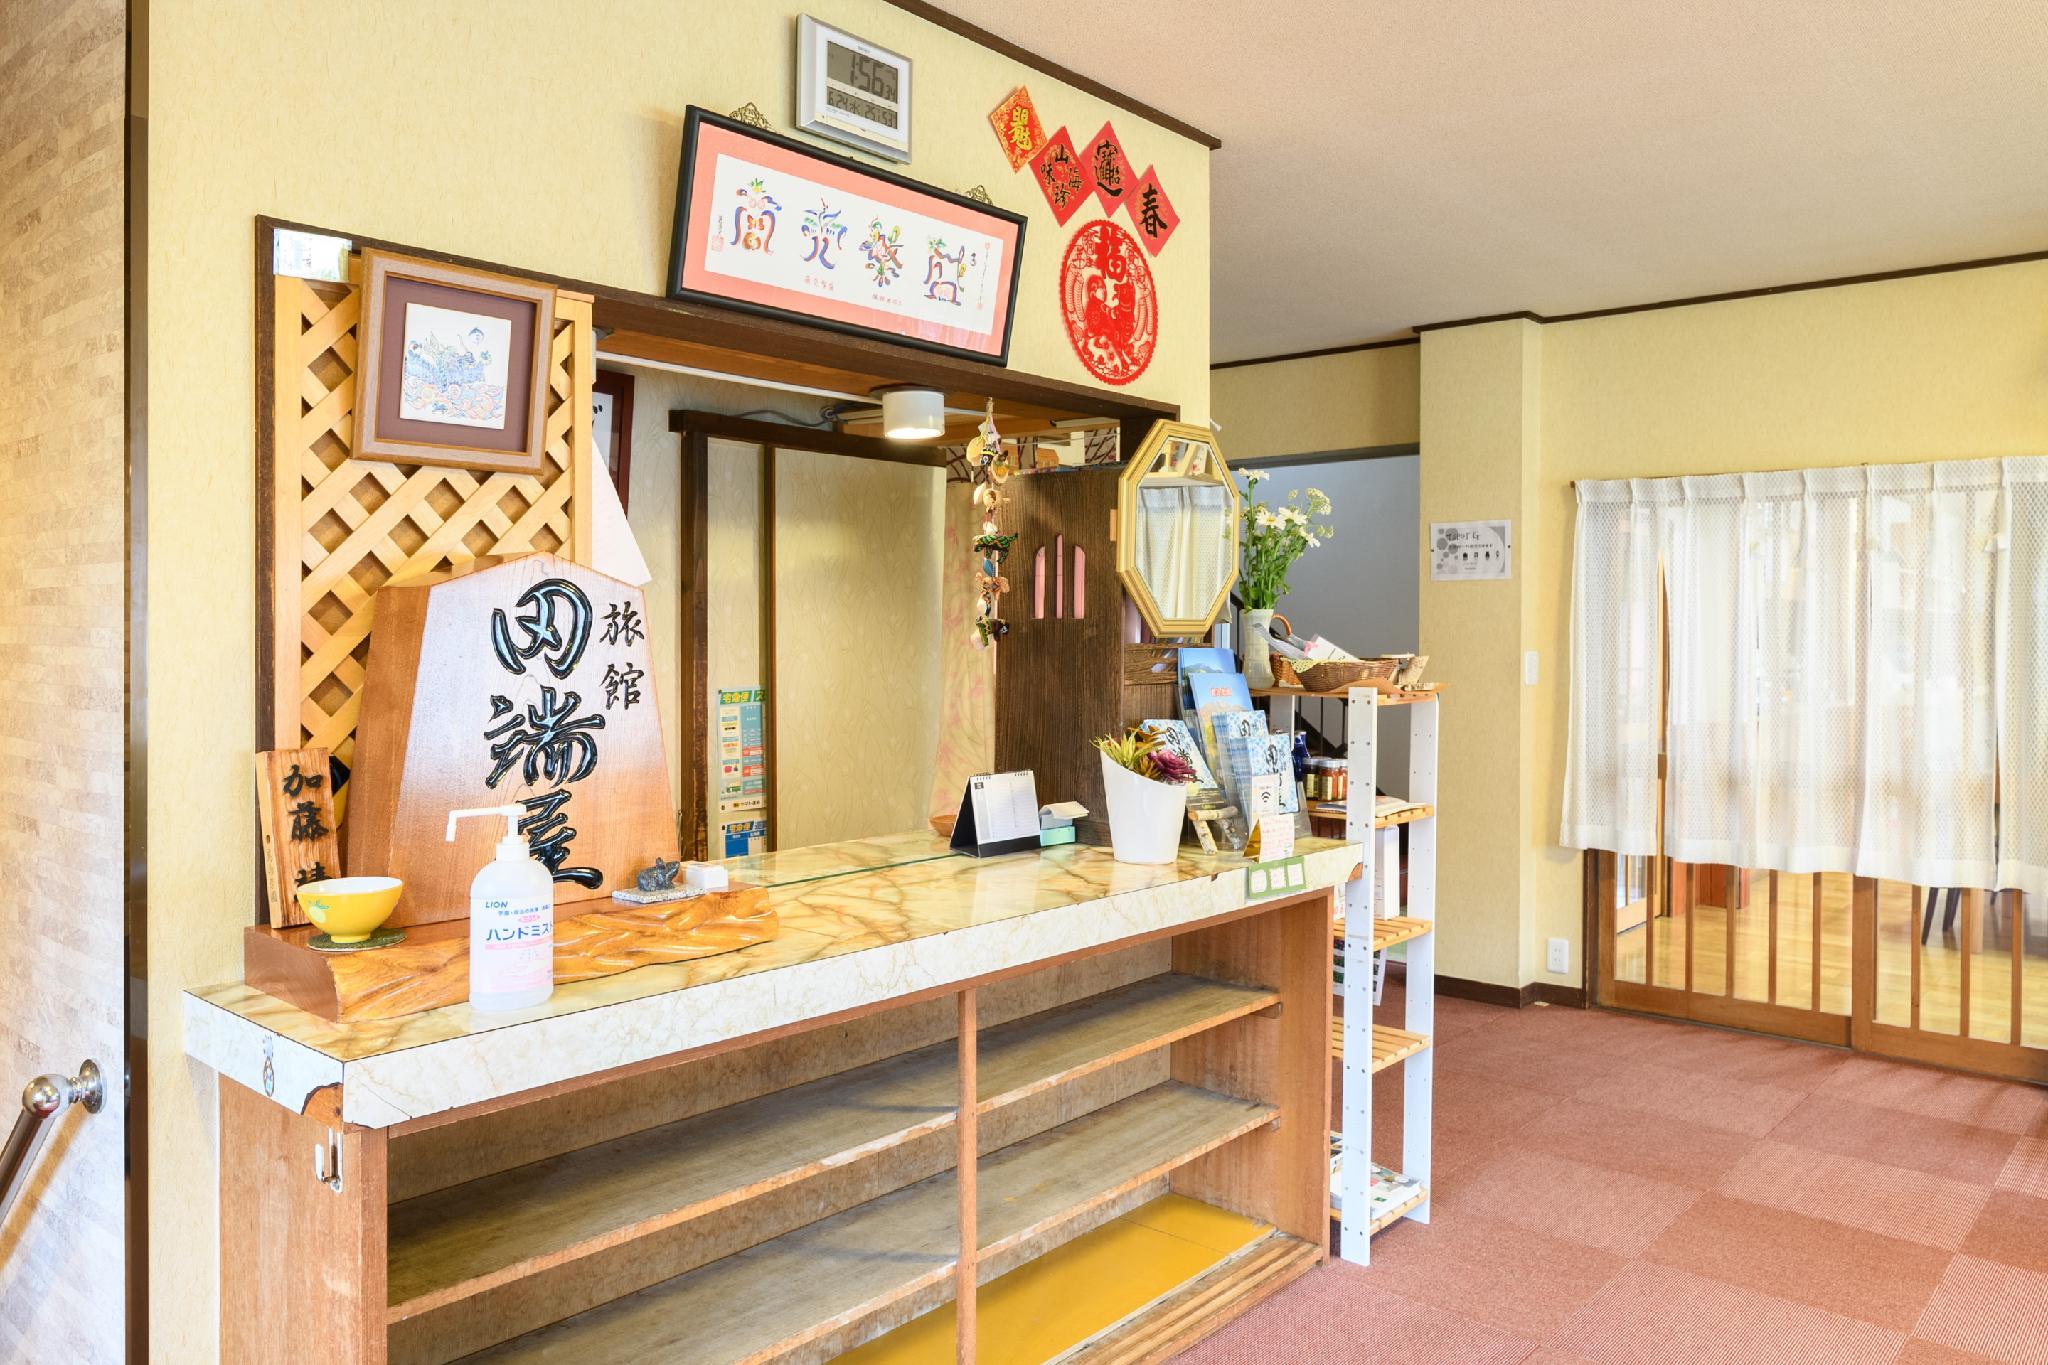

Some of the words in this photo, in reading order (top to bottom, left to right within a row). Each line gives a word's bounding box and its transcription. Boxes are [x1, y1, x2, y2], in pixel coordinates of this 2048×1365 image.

[1140, 182, 1168, 237] 春
[599, 601, 645, 711] 旅館
[485, 900, 508, 909] LION
